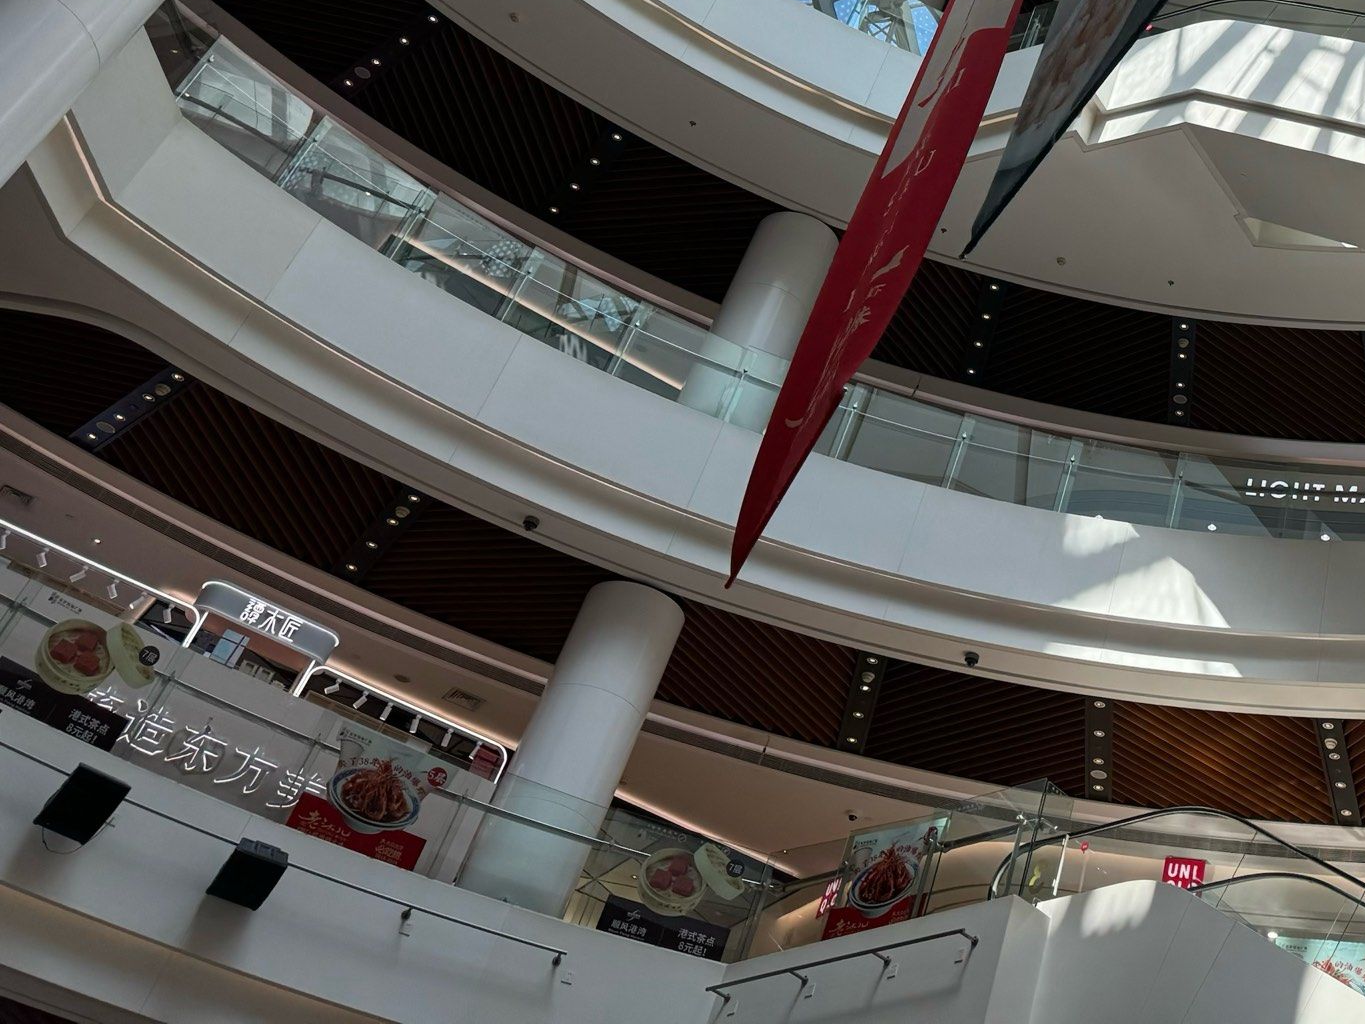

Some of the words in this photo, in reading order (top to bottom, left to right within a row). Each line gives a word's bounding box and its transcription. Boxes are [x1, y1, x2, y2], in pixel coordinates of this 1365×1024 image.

[69, 707, 111, 736] 港式茶点
[1167, 862, 1199, 880] UNI
[677, 927, 717, 948] 港式茶点
